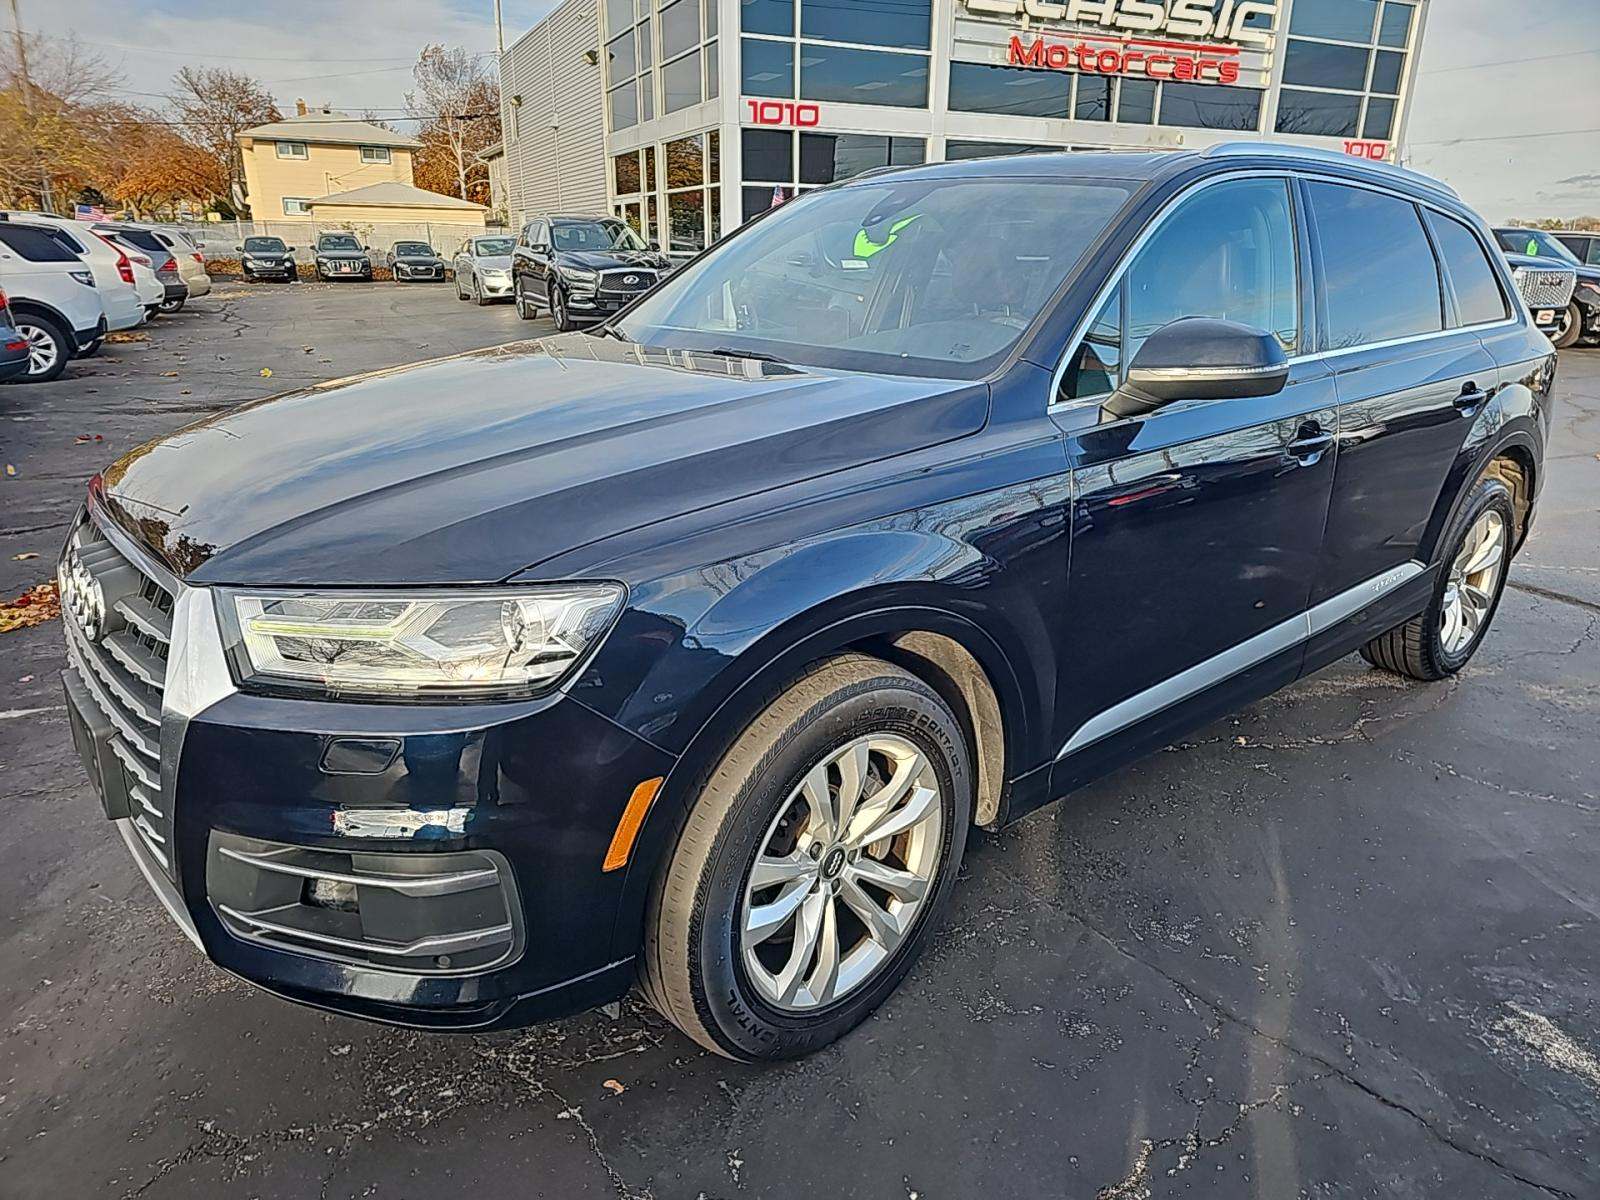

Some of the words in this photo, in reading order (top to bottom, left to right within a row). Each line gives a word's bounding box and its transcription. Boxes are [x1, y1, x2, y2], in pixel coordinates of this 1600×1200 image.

[1009, 36, 1239, 83] Motorcars
[747, 101, 819, 126] 1010
[1344, 141, 1386, 159] 1010
